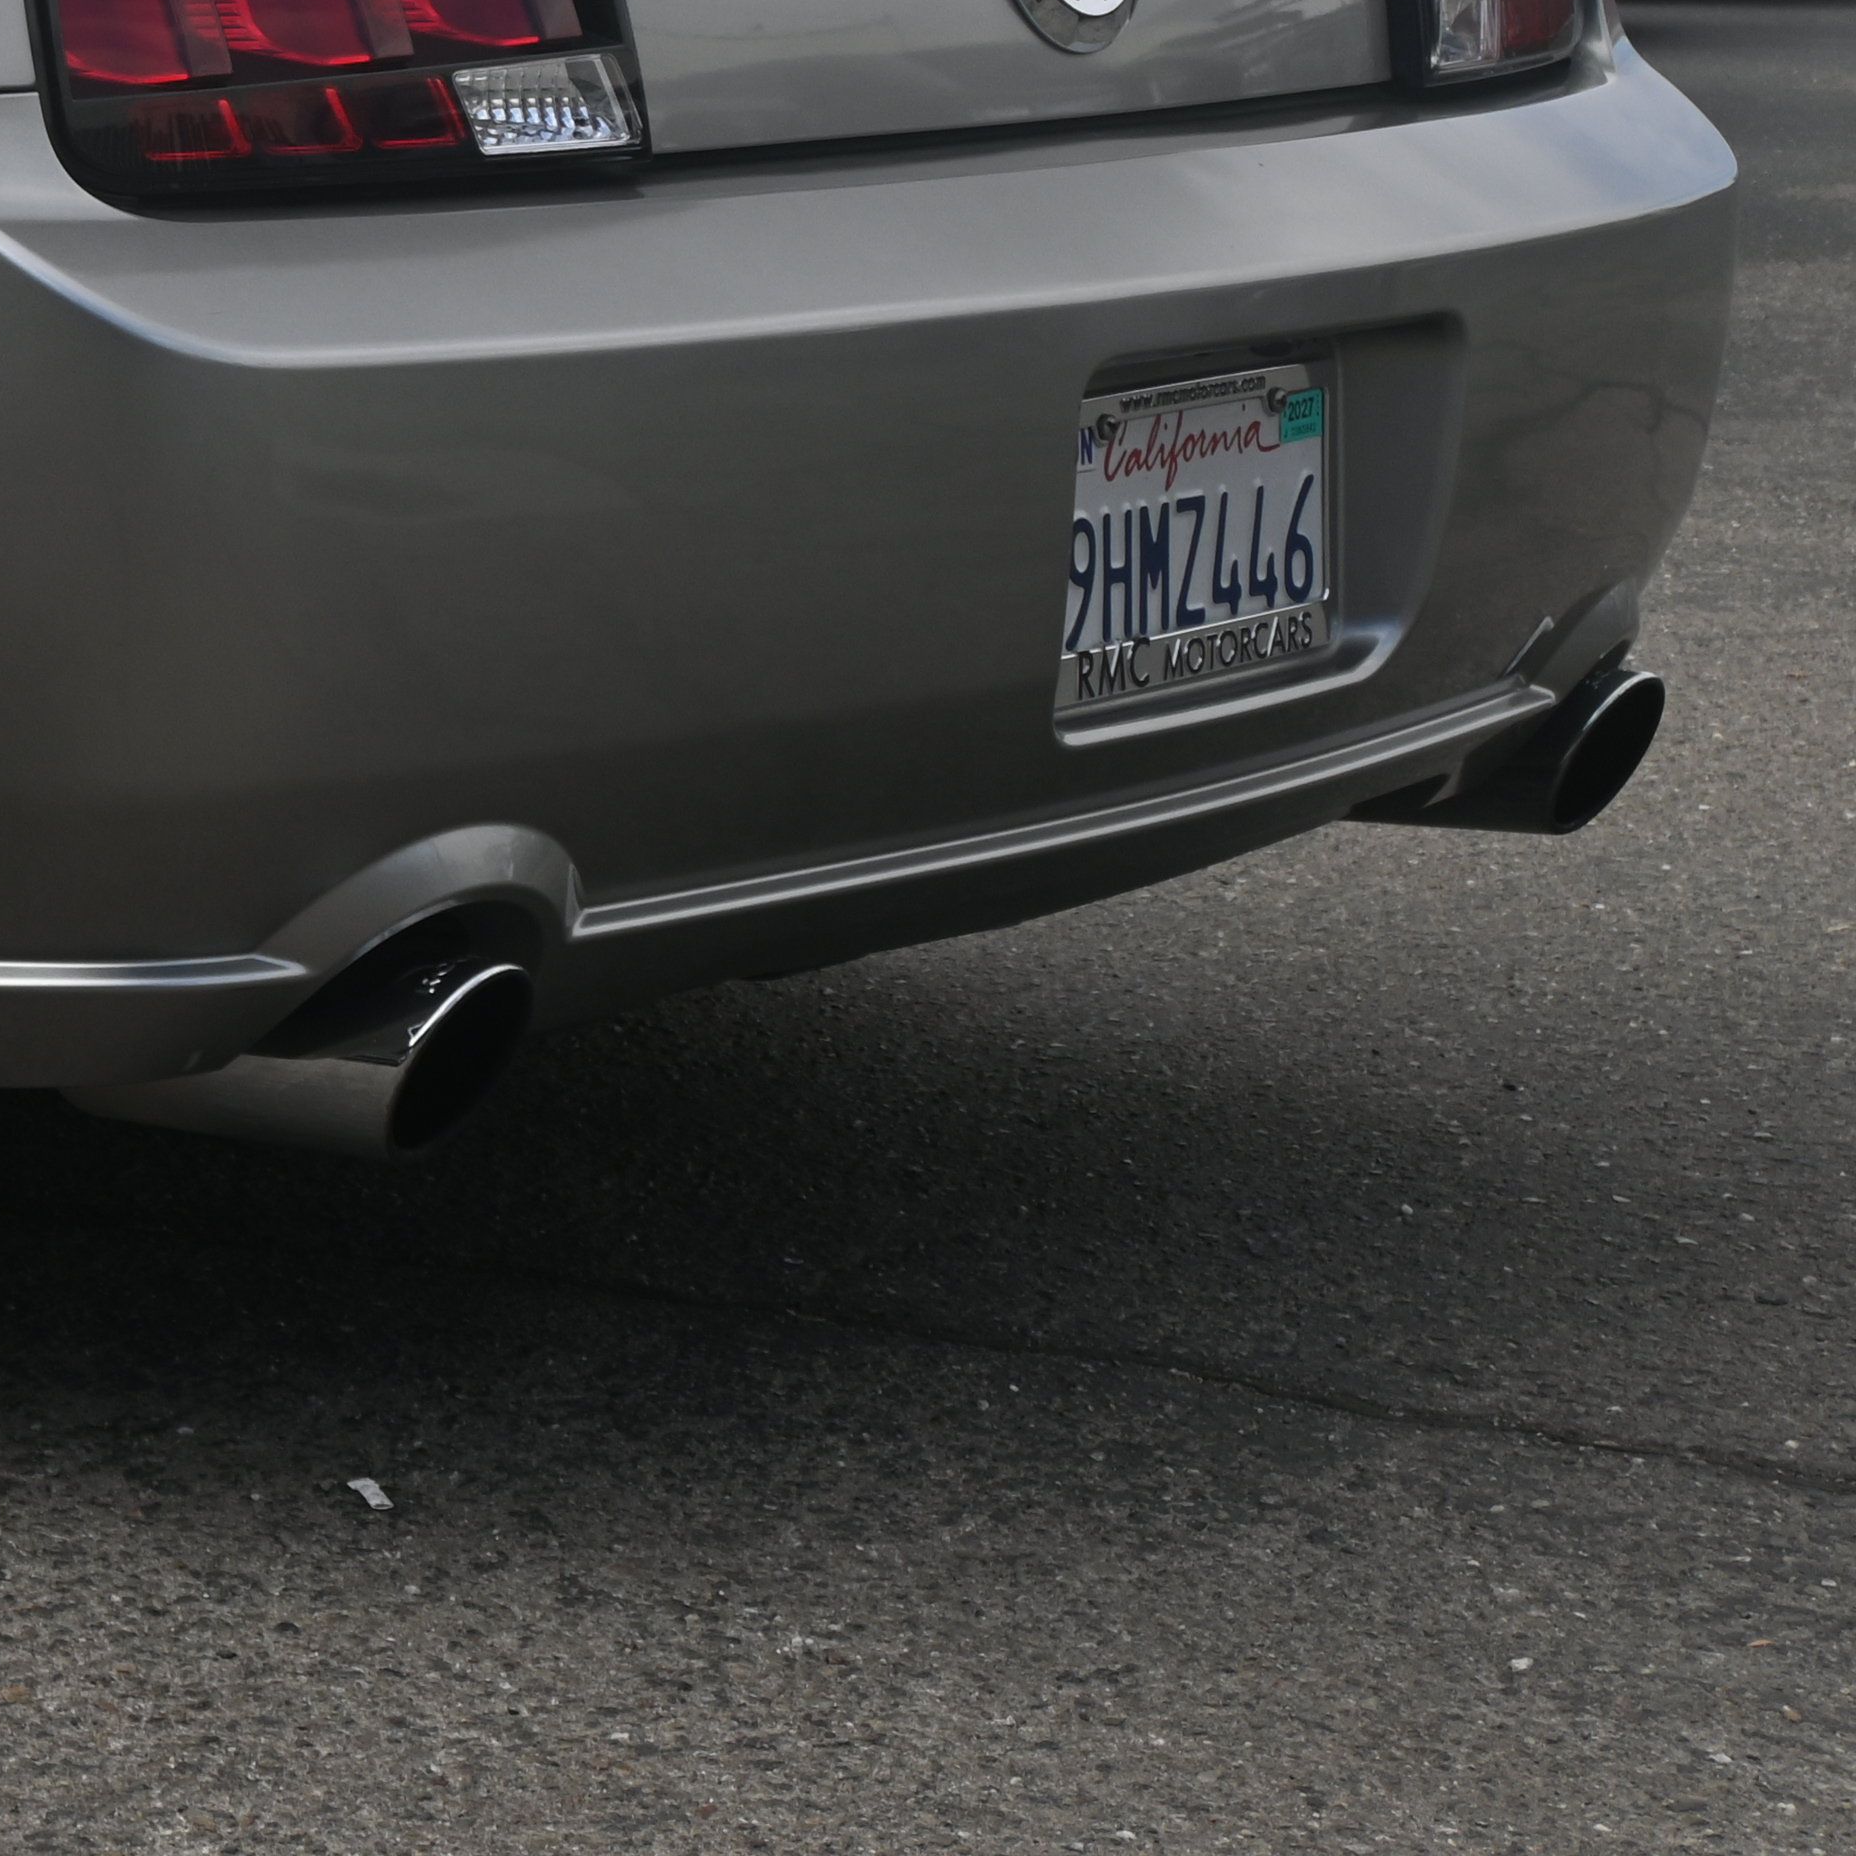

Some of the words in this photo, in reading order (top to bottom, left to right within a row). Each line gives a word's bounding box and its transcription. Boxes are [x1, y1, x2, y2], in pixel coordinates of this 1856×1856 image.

[1119, 374, 1266, 413] www.rmcmotorcars.com
[1288, 396, 1314, 421] 2027
[1103, 410, 1280, 491] California
[1065, 474, 1314, 651] 9HMZ446
[1078, 636, 1150, 702] RMC
[1164, 611, 1313, 682] MOTORCARS
